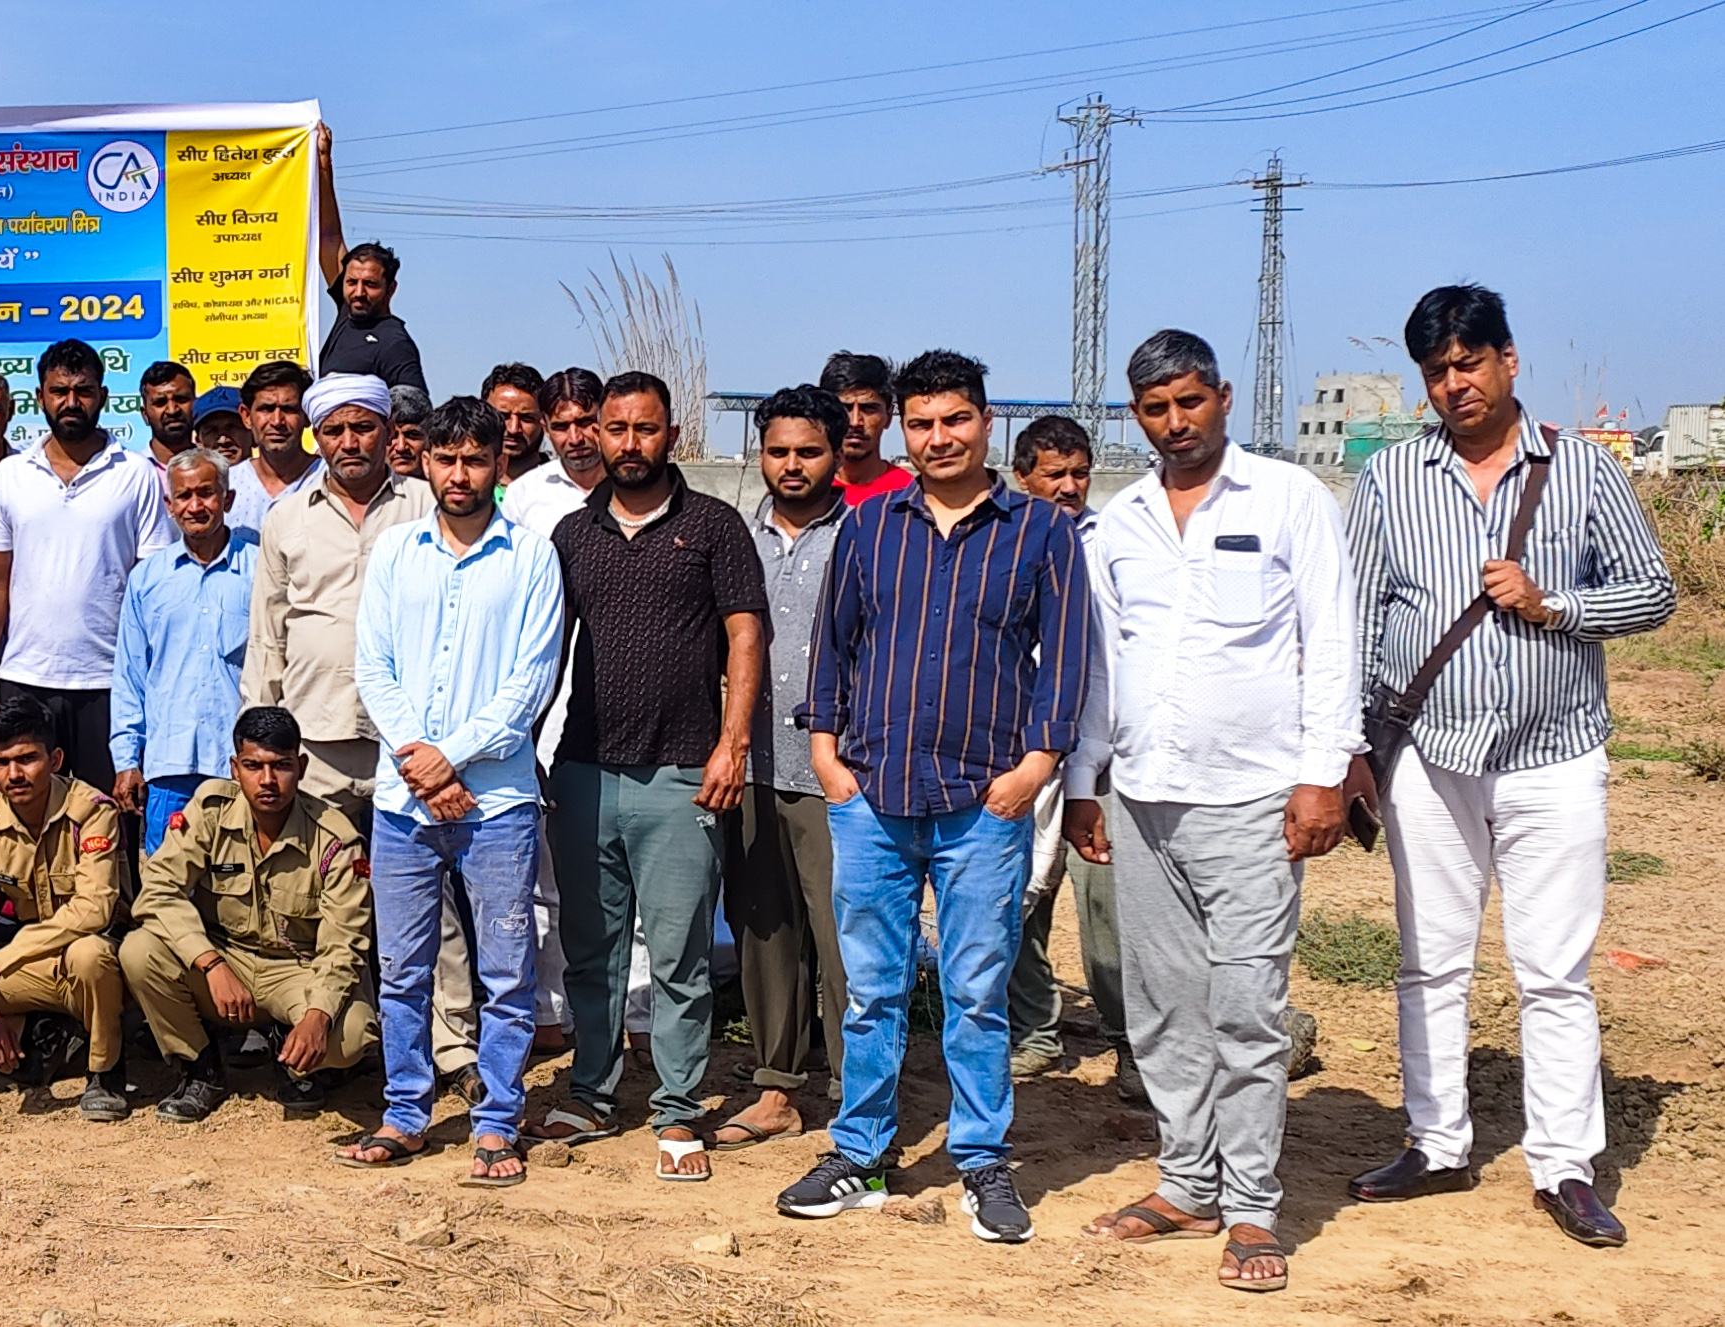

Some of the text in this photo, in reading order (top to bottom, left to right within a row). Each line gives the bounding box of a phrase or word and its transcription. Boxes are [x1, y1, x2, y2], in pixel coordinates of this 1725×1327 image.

[176, 145, 209, 162] सीए
[213, 145, 259, 162] हितेश
[93, 151, 153, 190] CA
[212, 171, 252, 182] अध्यक्ष
[98, 191, 148, 202] INDIA
[7, 211, 68, 234] पर्यावरण
[70, 209, 102, 234] मित्र
[195, 208, 279, 226] सीए विजय
[213, 232, 262, 243] उपाध्यक्ष
[170, 262, 291, 288] सीए शुभम गर्ग
[59, 294, 145, 323] 2024
[178, 347, 301, 365] सीए वरुण वत्स
[87, 837, 109, 850] NCC
